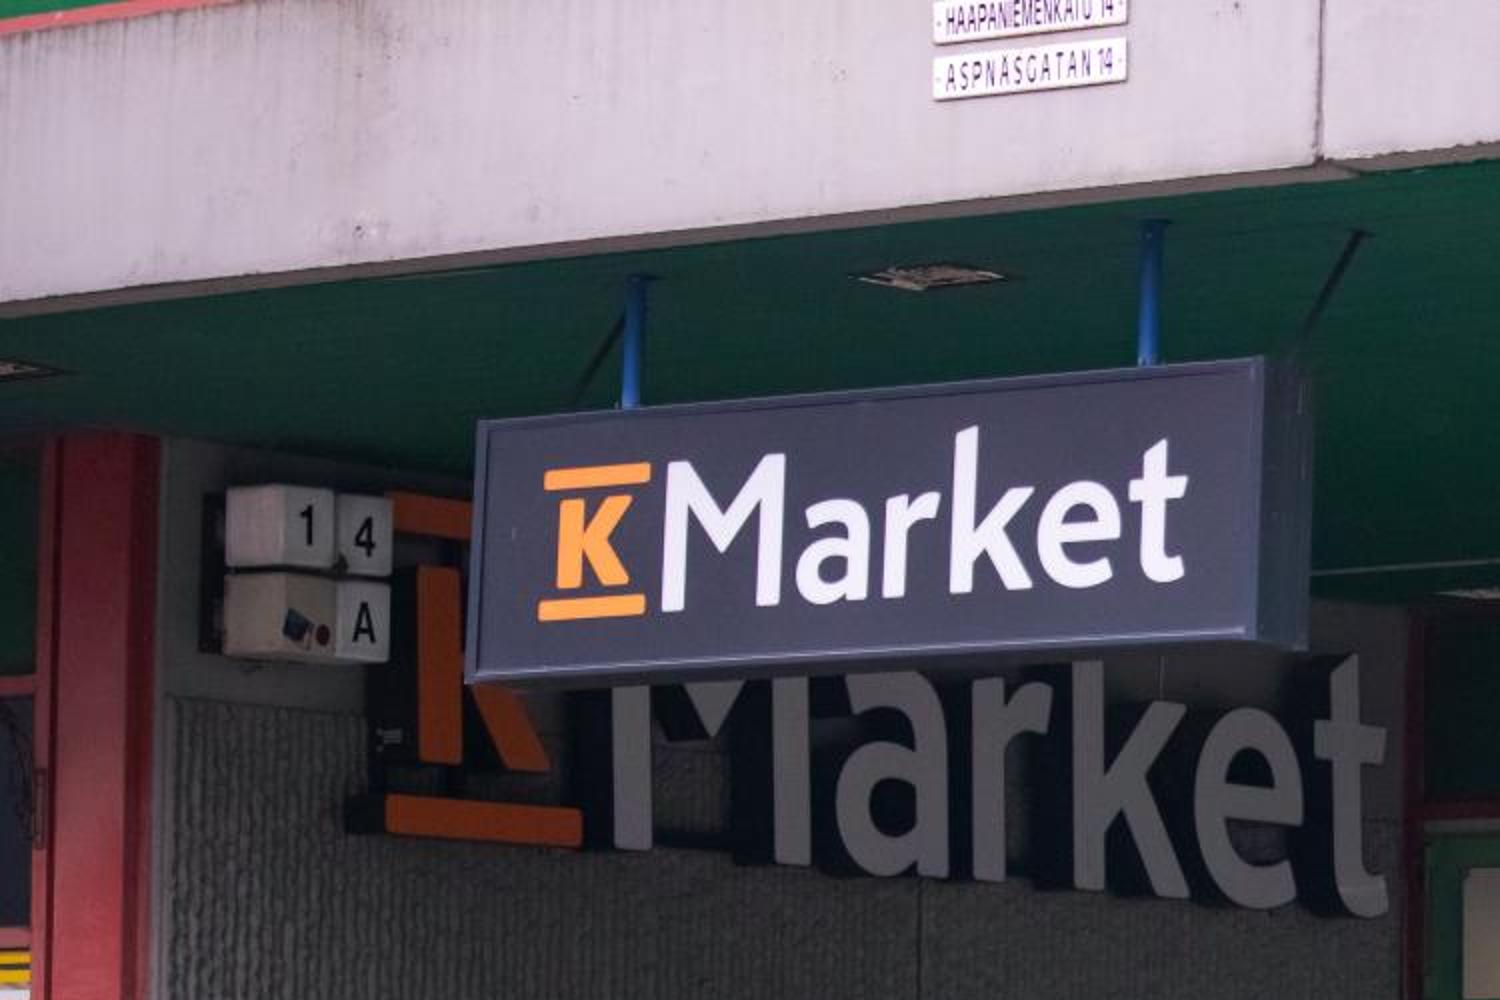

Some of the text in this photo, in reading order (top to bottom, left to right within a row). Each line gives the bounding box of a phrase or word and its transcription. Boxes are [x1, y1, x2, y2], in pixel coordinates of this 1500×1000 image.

[1098, 47, 1114, 76] 14
[660, 425, 1190, 614] Market
[352, 601, 377, 644] A
